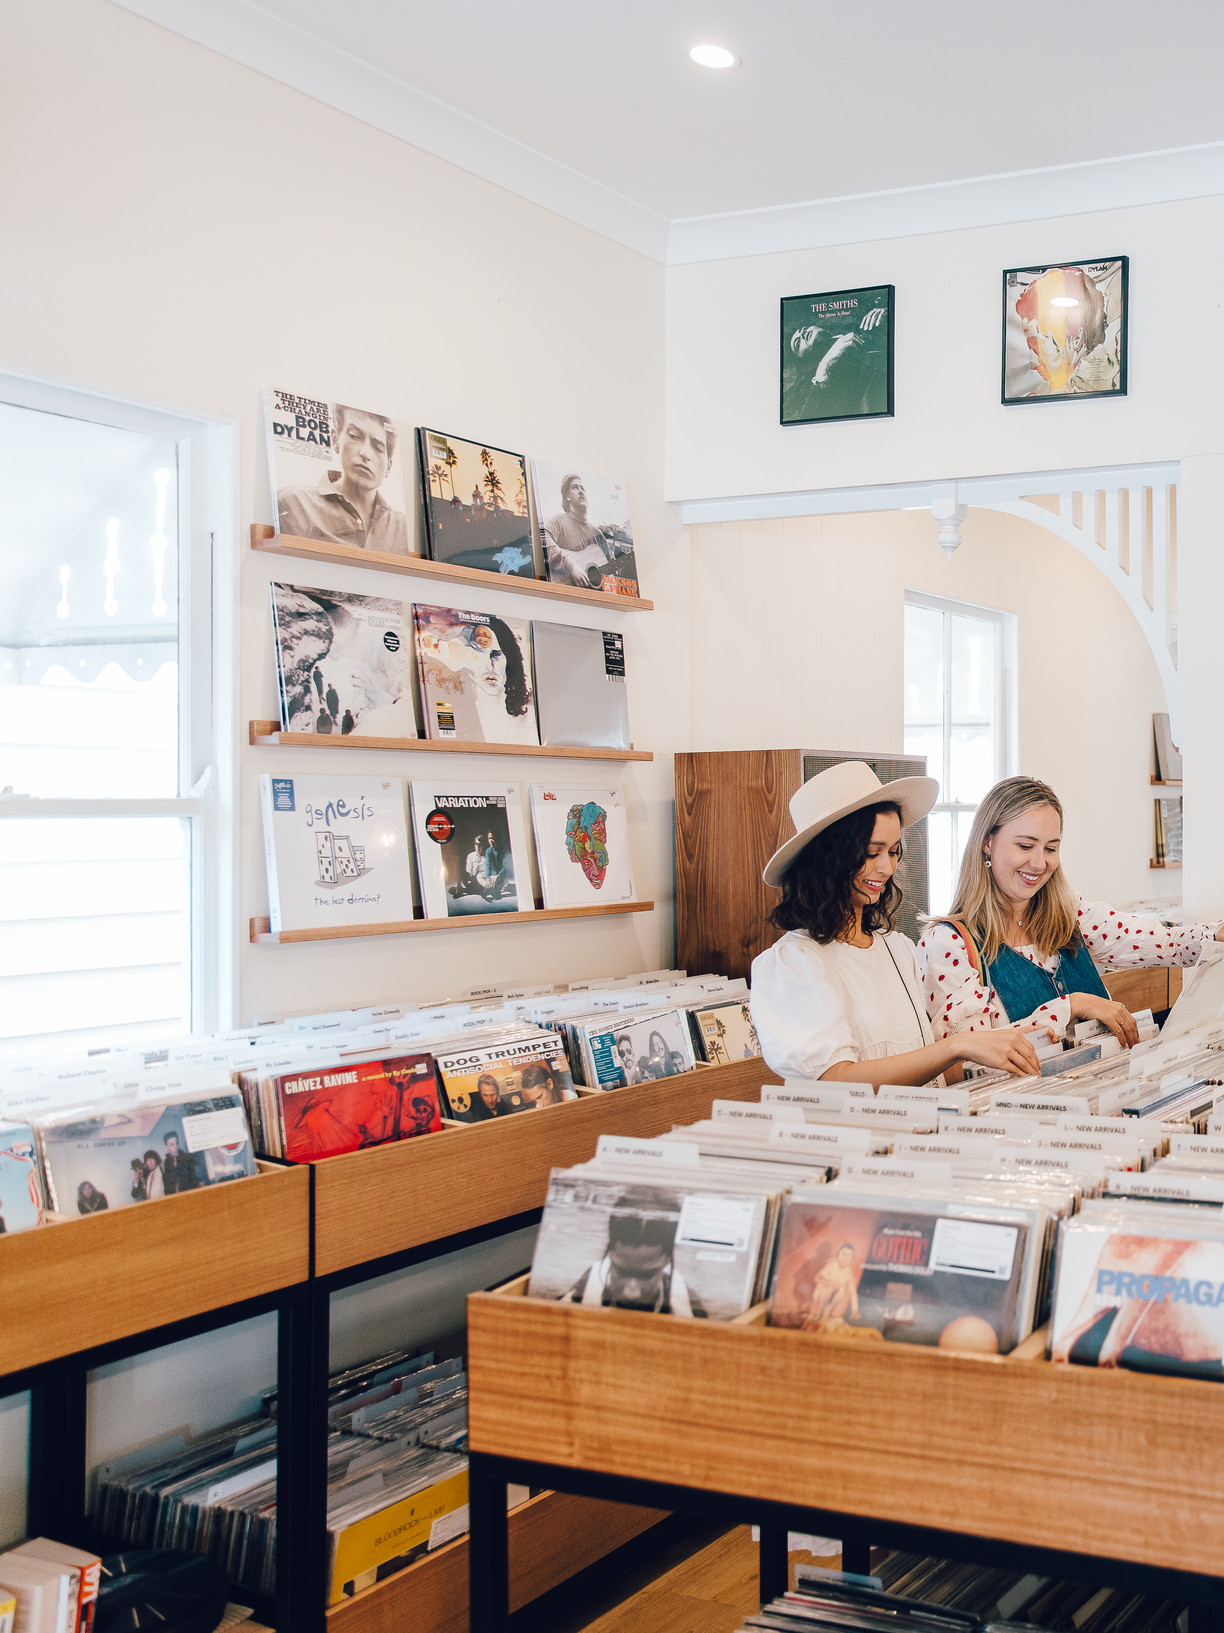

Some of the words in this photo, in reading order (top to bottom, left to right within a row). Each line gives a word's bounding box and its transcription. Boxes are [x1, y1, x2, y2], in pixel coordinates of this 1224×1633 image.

[810, 303, 828, 312] THE
[828, 299, 859, 310] SMITHS
[274, 390, 296, 401] THE
[297, 396, 328, 410] TIMES
[281, 398, 309, 412] THEY
[309, 405, 329, 416] ARE
[295, 415, 330, 434] BOB
[273, 422, 331, 447] DYLAN
[458, 612, 471, 620] The
[471, 613, 491, 623] Doors
[434, 796, 488, 808] VARIATION
[305, 795, 375, 828] genesis
[443, 1056, 480, 1068] DOG
[485, 1040, 559, 1060] TRUMPET
[446, 1061, 506, 1079] ANTISOCIAL
[508, 1049, 564, 1067] TENDENCIES
[366, 1073, 385, 1081] record
[146, 1085, 166, 1093] Cheap
[168, 1081, 182, 1089] Trick
[284, 1077, 323, 1095] CHÁVEZ
[323, 1071, 359, 1089] RAVINE
[1036, 1104, 1067, 1112] ARRIVALS
[745, 1112, 773, 1120] ARRIVALS
[1094, 1126, 1126, 1134] ARRIVALS
[808, 1134, 838, 1143] ARRIVALS
[928, 1147, 960, 1155] ARRIVALS
[1068, 1142, 1102, 1150] ARRIVALS
[1190, 1145, 1208, 1153] NEW
[632, 1148, 663, 1157] ARRIVALS
[1034, 1160, 1068, 1168] ARRIVALS
[862, 1168, 878, 1176] NEW
[880, 1170, 914, 1178] ARRIVALS
[1131, 1185, 1150, 1193] NEW
[1152, 1187, 1190, 1197] ARRIVALS
